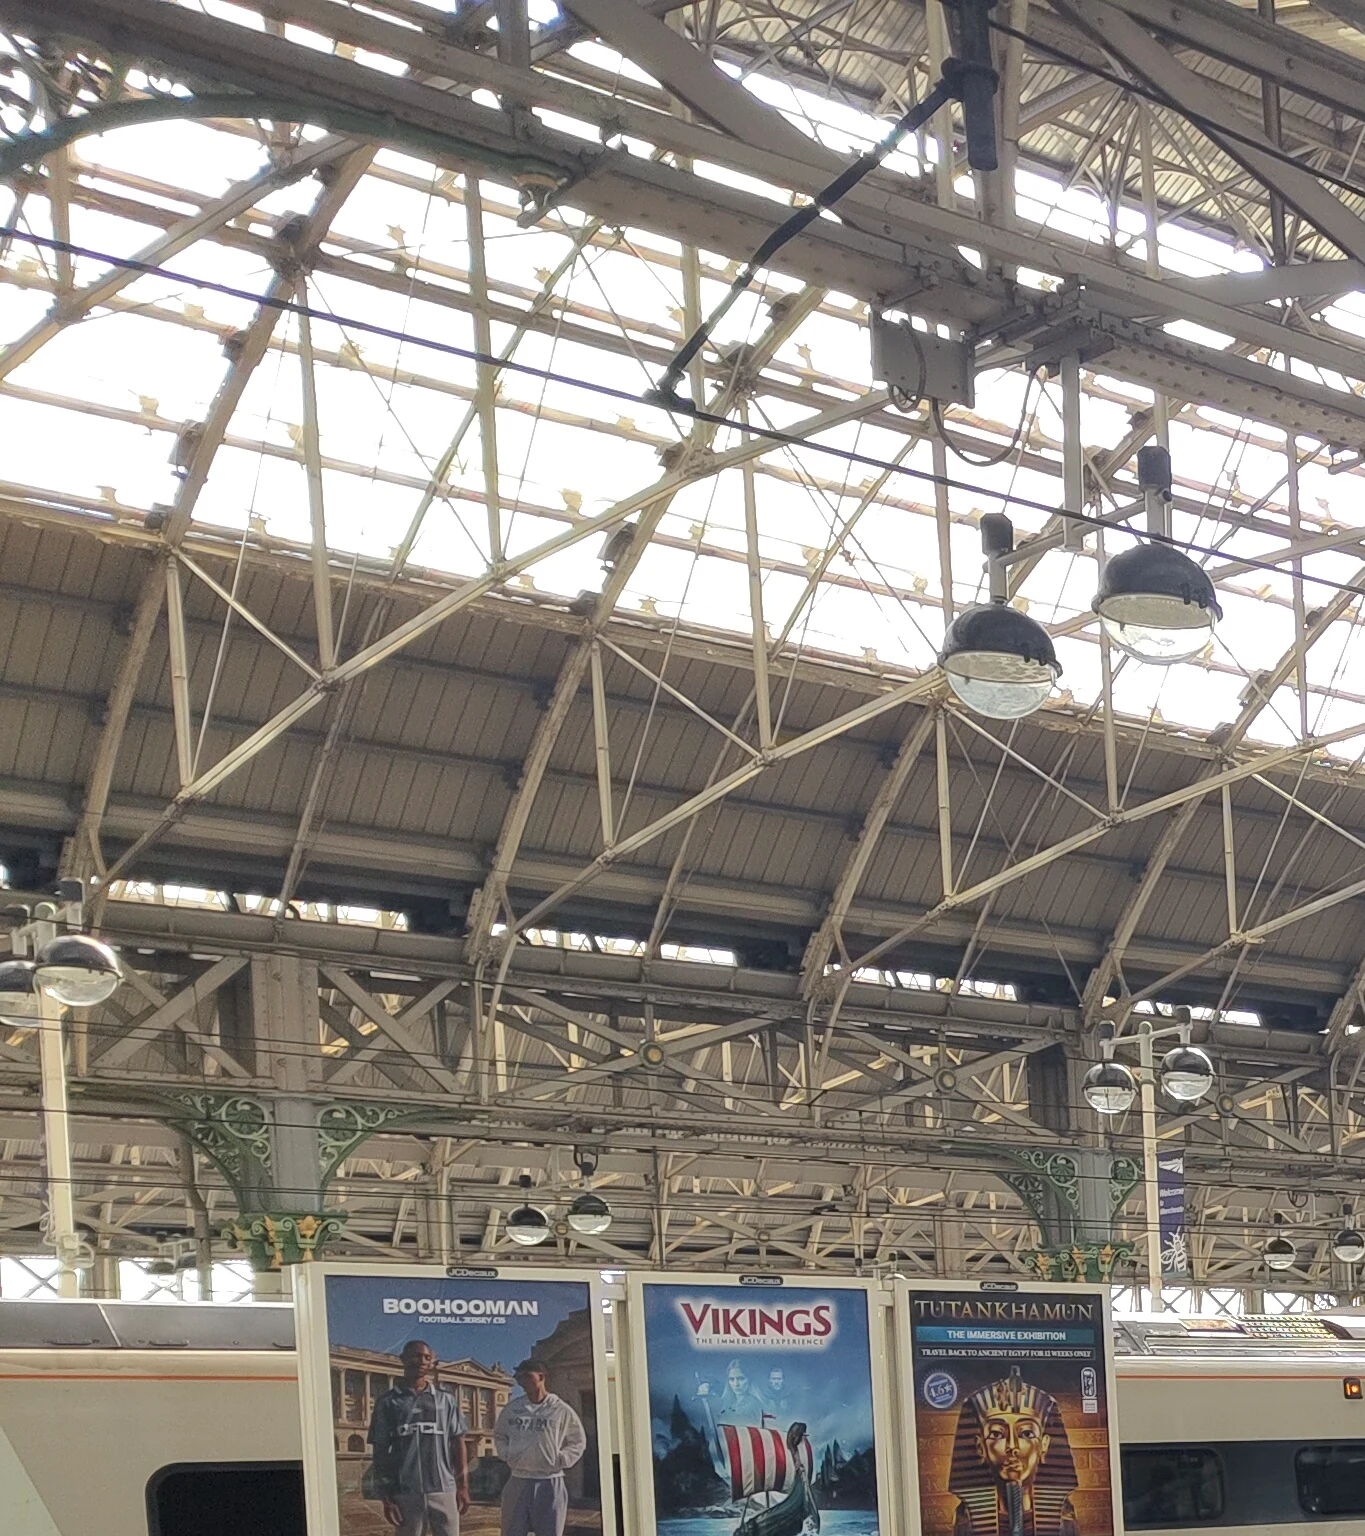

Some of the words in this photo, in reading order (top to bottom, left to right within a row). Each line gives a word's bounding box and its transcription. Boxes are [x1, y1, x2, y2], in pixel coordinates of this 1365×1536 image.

[449, 1268, 497, 1277] JCDecaux
[382, 1298, 539, 1316] BOOHOOMAN
[914, 1300, 1093, 1321] TUTANKHAMUN
[418, 1315, 461, 1324] FOOTBALL
[680, 1303, 832, 1337] VIKINGS
[947, 1330, 965, 1339] THE
[966, 1330, 1016, 1340] IMMERSIVE
[1017, 1331, 1066, 1341] EXHIBITION
[770, 1338, 825, 1346] EXPERIENCE
